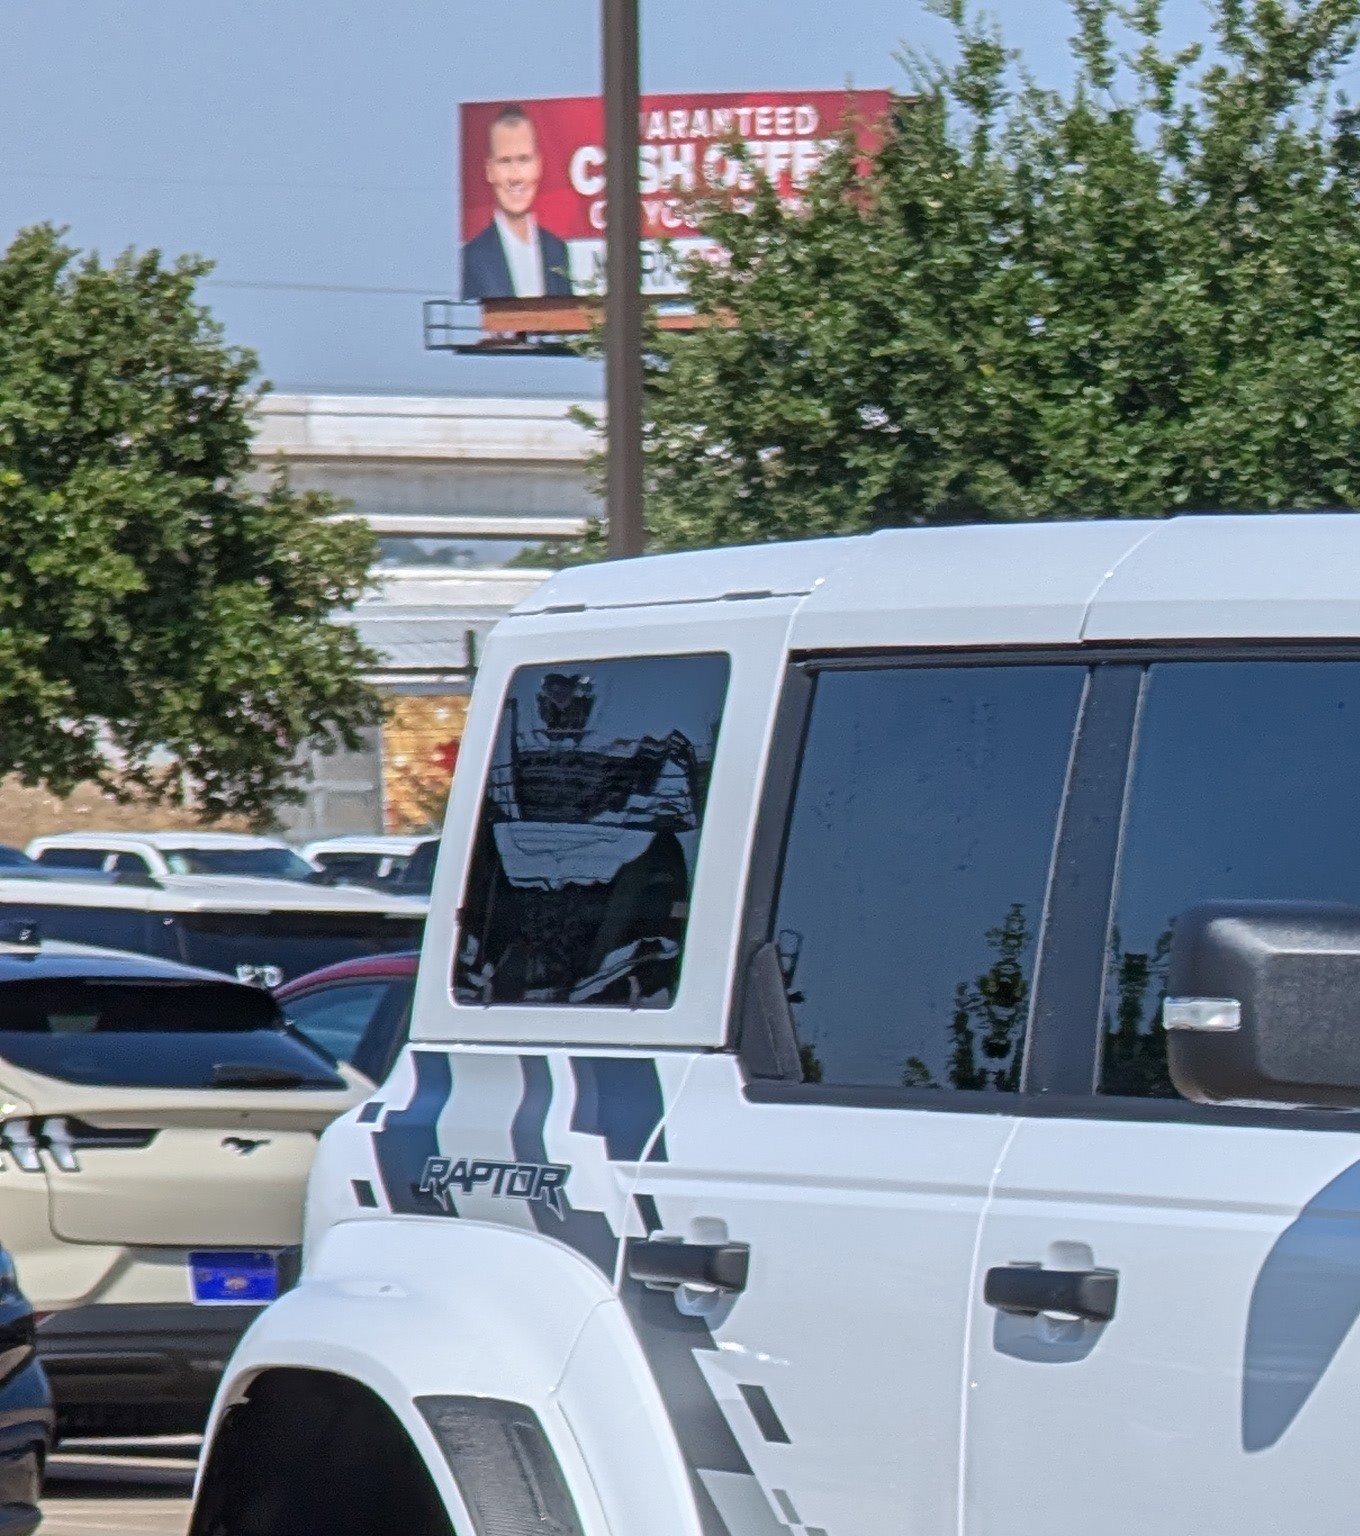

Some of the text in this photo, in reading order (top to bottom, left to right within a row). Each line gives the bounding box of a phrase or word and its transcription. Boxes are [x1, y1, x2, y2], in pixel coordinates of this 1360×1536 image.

[639, 104, 820, 139] ARANTEED
[568, 143, 697, 196] CSH
[419, 1156, 572, 1221] RAPTOR
